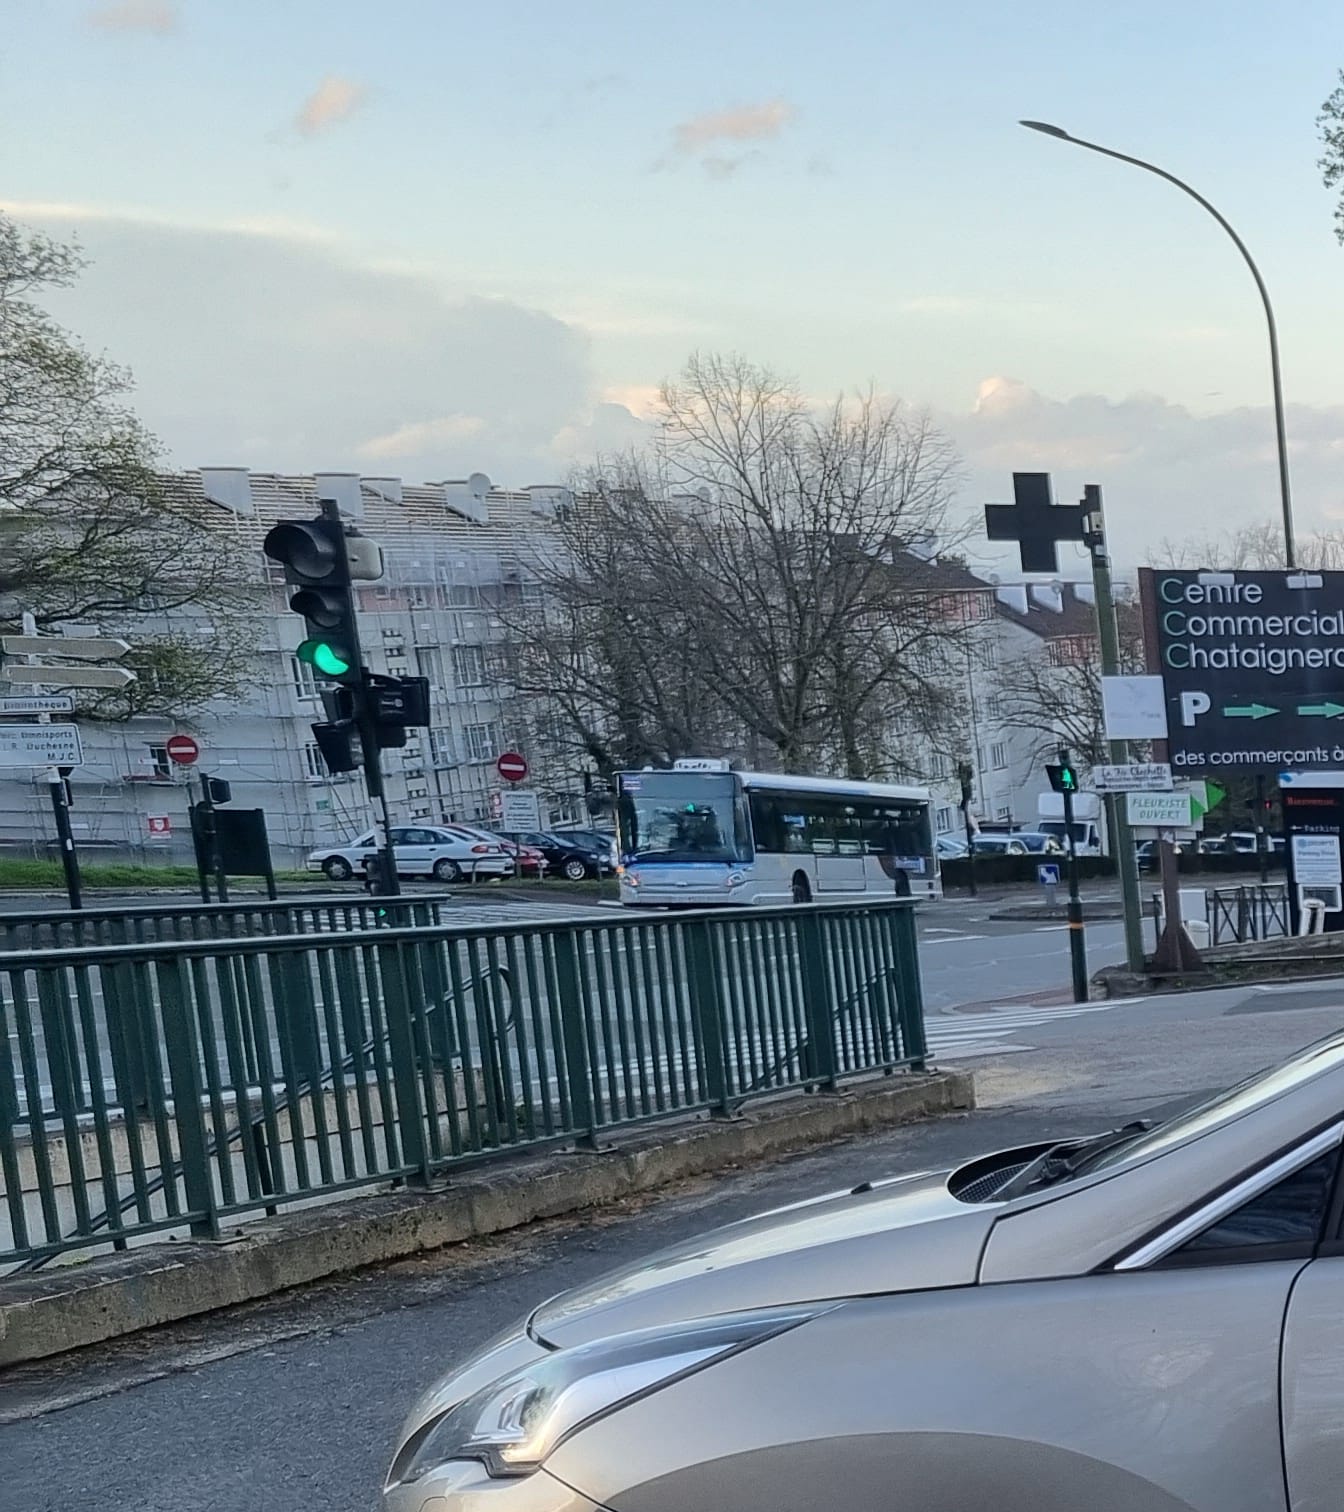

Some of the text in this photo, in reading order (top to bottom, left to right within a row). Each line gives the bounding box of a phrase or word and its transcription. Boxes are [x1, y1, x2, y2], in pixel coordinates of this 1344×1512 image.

[1163, 609, 1344, 636] Commercial
[1180, 691, 1212, 726] P
[1174, 749, 1206, 766] des
[1210, 746, 1330, 766] commerçants
[1132, 799, 1188, 809] FLEURISTE
[1139, 810, 1181, 820] OUVERT
